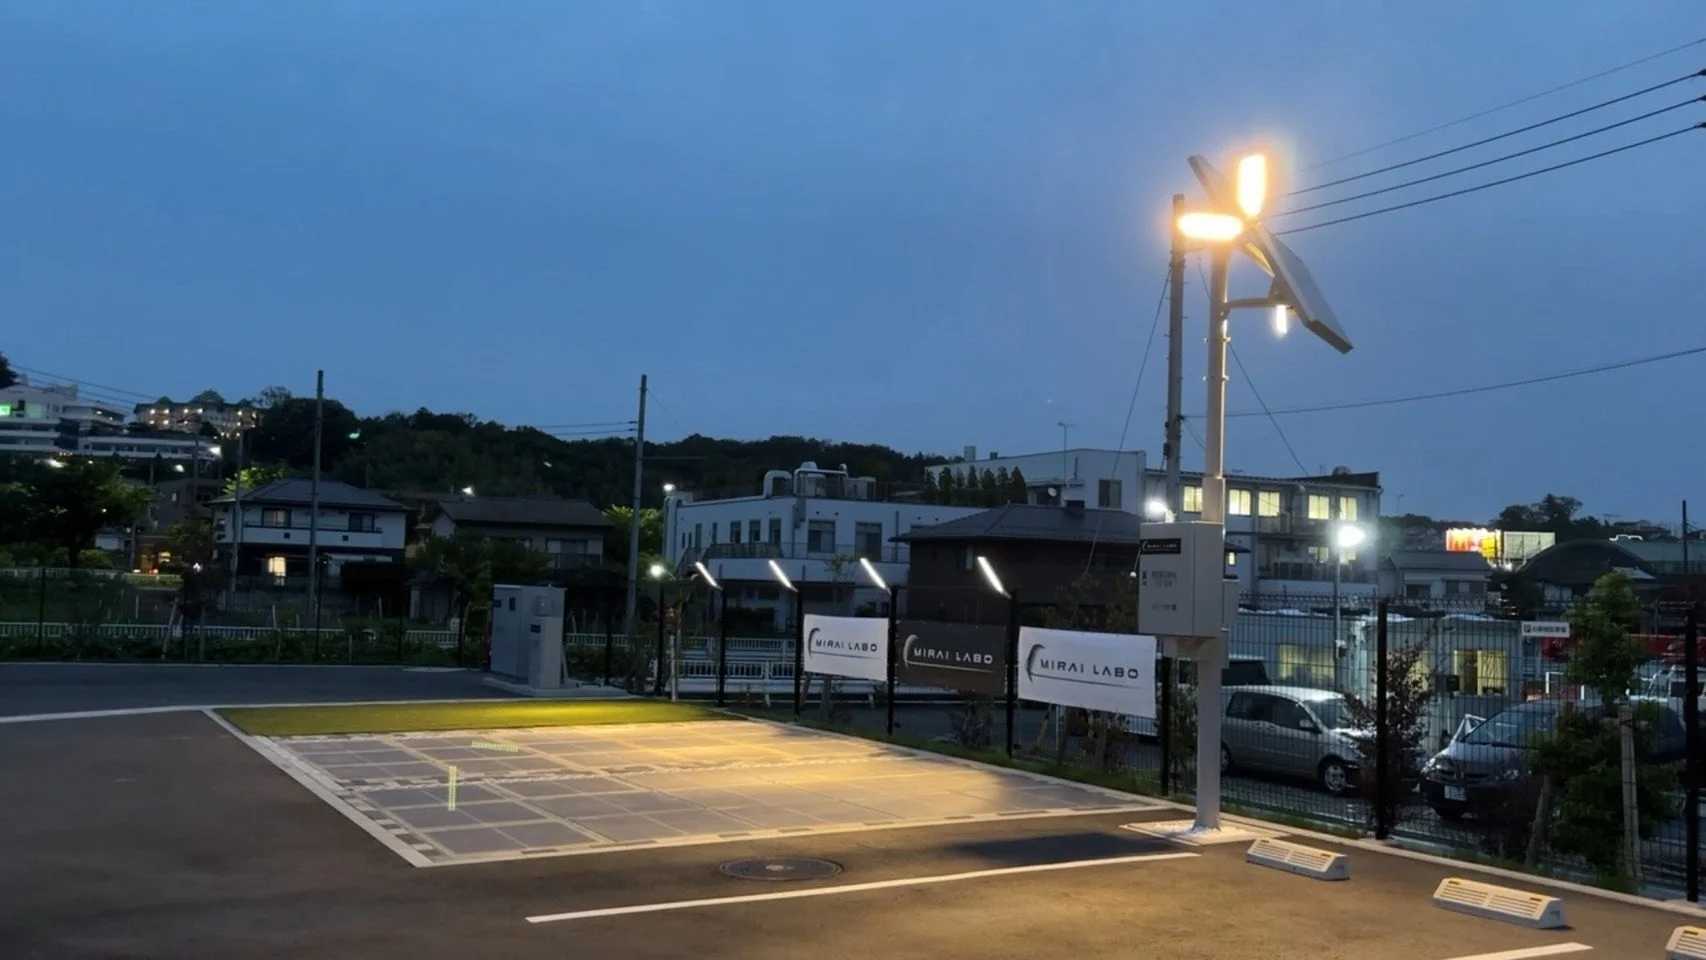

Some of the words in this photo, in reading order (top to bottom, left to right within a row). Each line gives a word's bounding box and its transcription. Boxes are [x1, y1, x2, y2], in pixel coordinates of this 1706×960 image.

[816, 639, 844, 649] MIRAI
[848, 642, 878, 652] LABO
[913, 648, 949, 660] MIRAI
[955, 651, 993, 664] LABO
[1040, 658, 1084, 674] MIRAI
[1092, 664, 1139, 679] LABO
